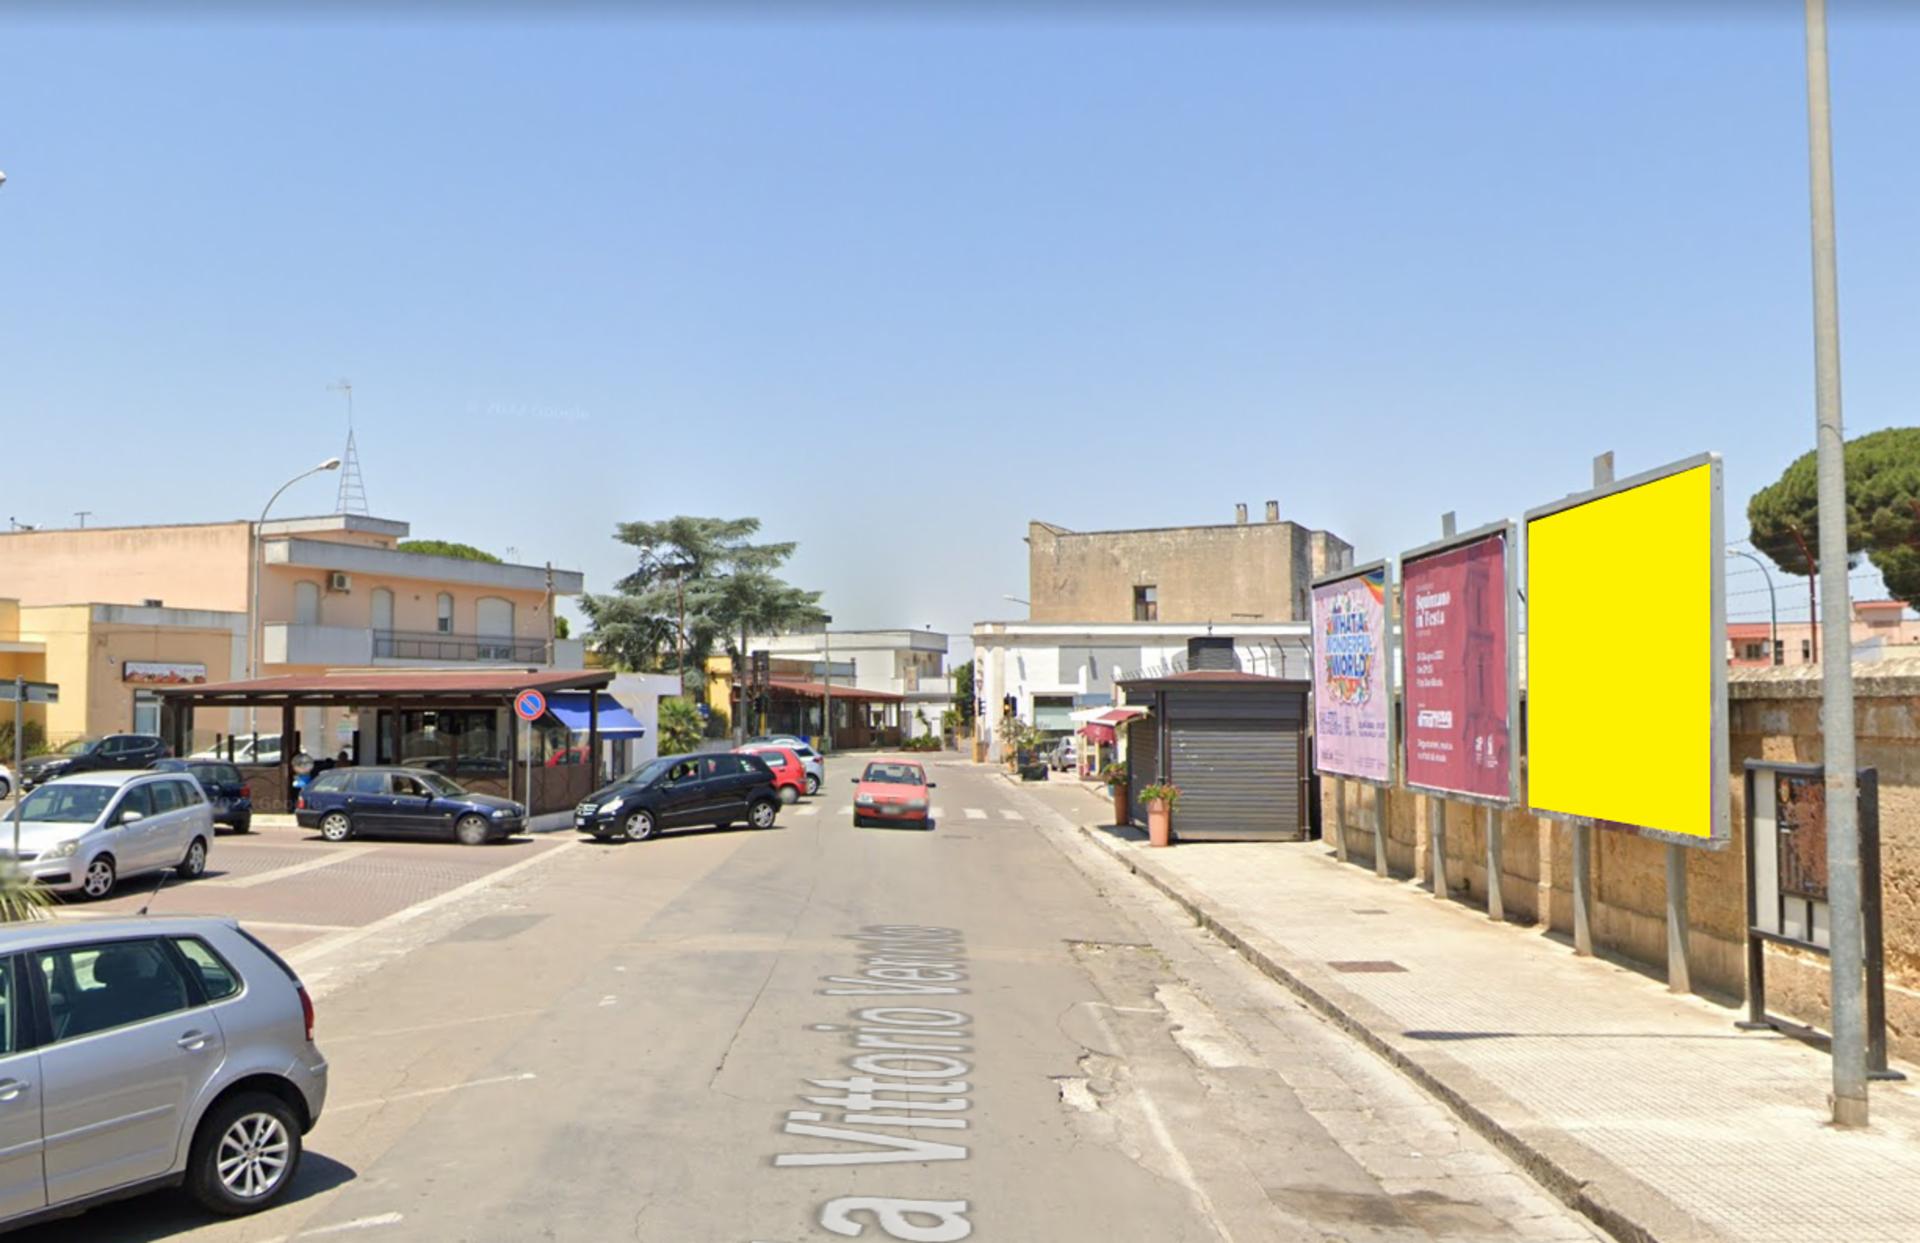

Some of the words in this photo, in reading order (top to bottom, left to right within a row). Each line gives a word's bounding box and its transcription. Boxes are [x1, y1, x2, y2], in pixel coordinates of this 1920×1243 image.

[1333, 612, 1357, 634] WHAT
[1327, 635, 1373, 654] WONDERFUL
[1332, 654, 1367, 677] WORLD
